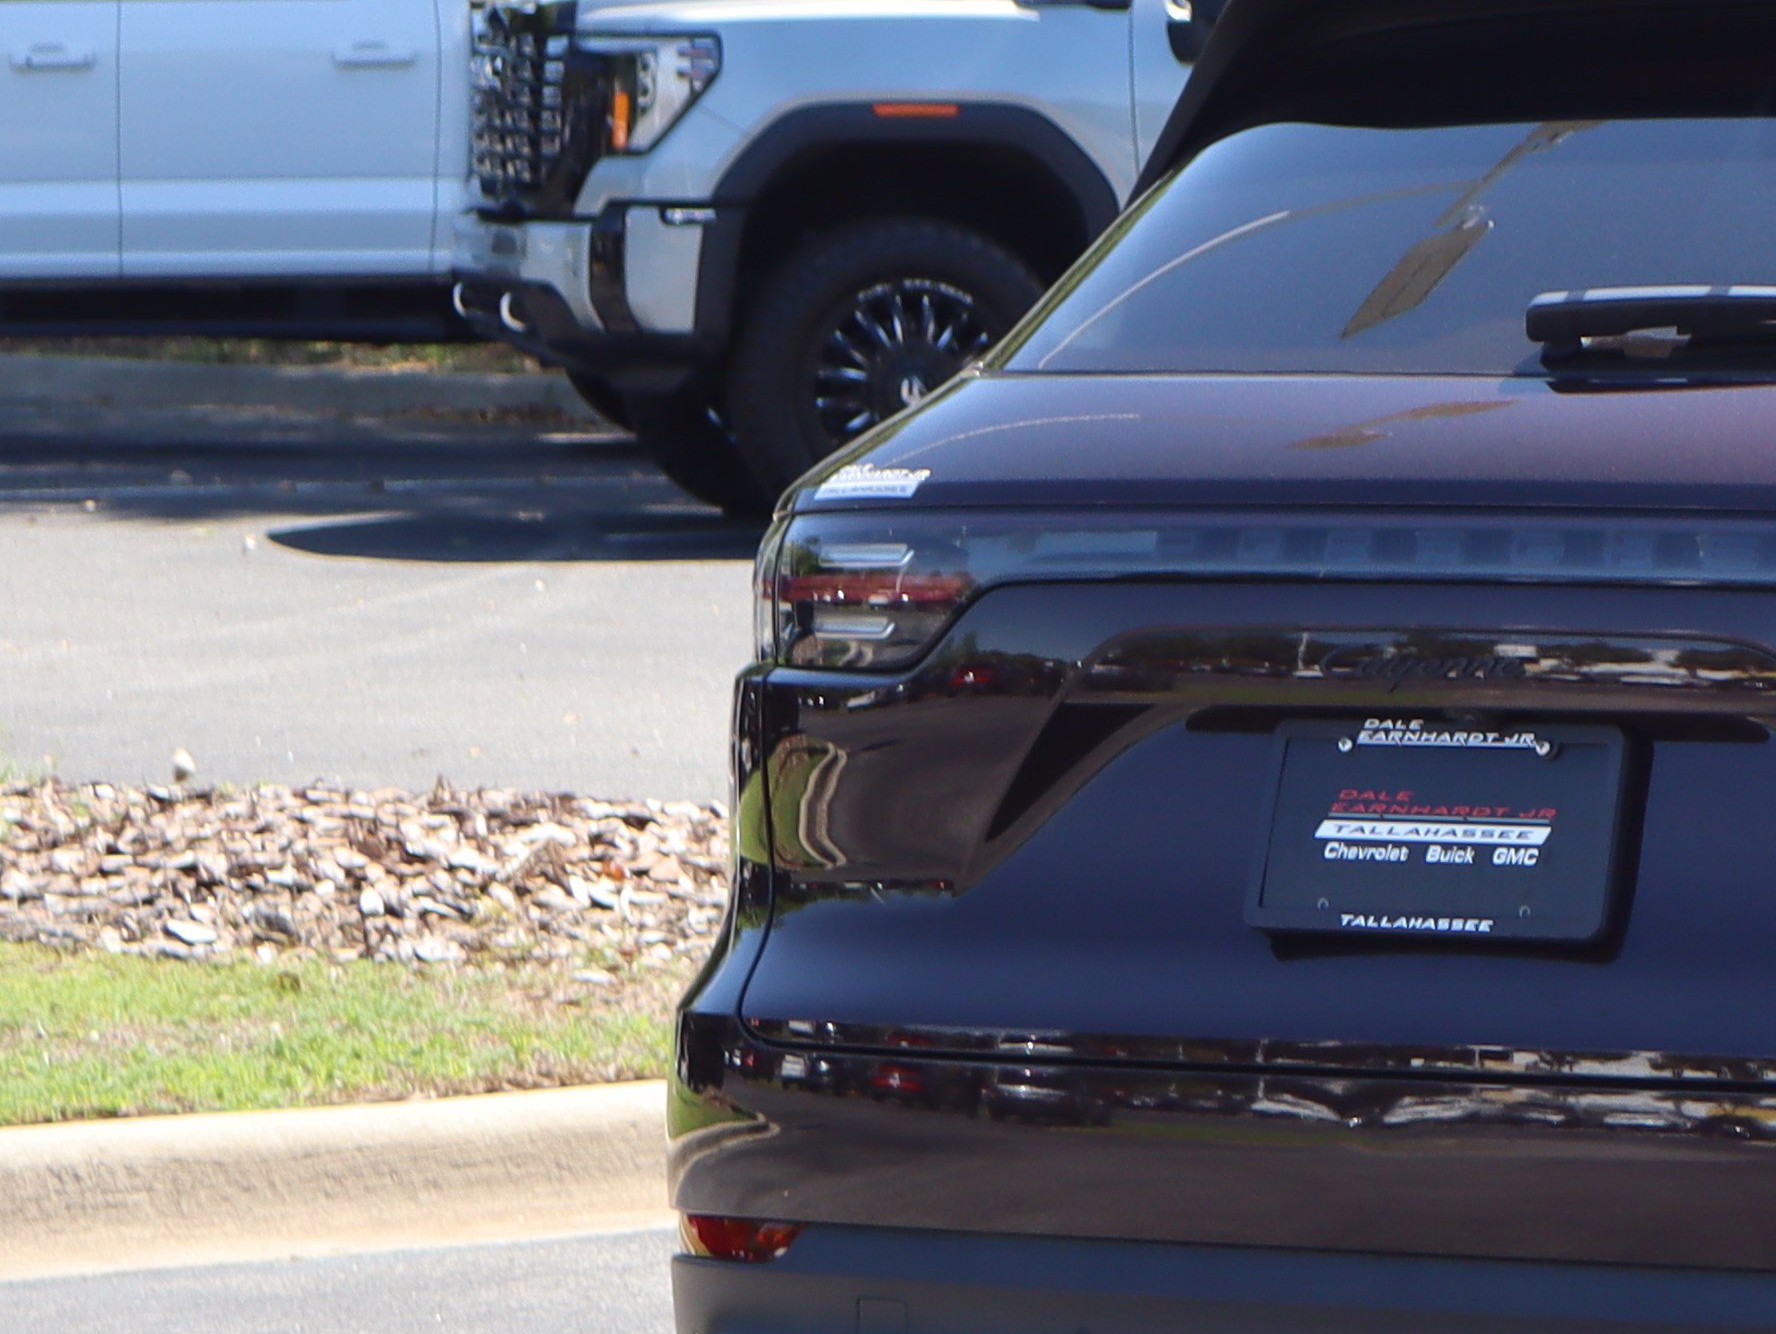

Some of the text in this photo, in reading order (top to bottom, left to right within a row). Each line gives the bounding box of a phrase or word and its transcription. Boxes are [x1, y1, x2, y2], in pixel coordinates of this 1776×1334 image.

[1320, 644, 1525, 694] Cayenne
[1364, 718, 1424, 730] DALE
[1357, 730, 1536, 747] EARNHARDT JR
[1338, 789, 1414, 801] DALE
[1330, 802, 1557, 820] EARNHARDT JR
[1332, 823, 1534, 841] TALLAHASSEE
[1323, 841, 1539, 866] Chevrolet Buick GMC
[1340, 913, 1494, 933] TALLAHASSEE
